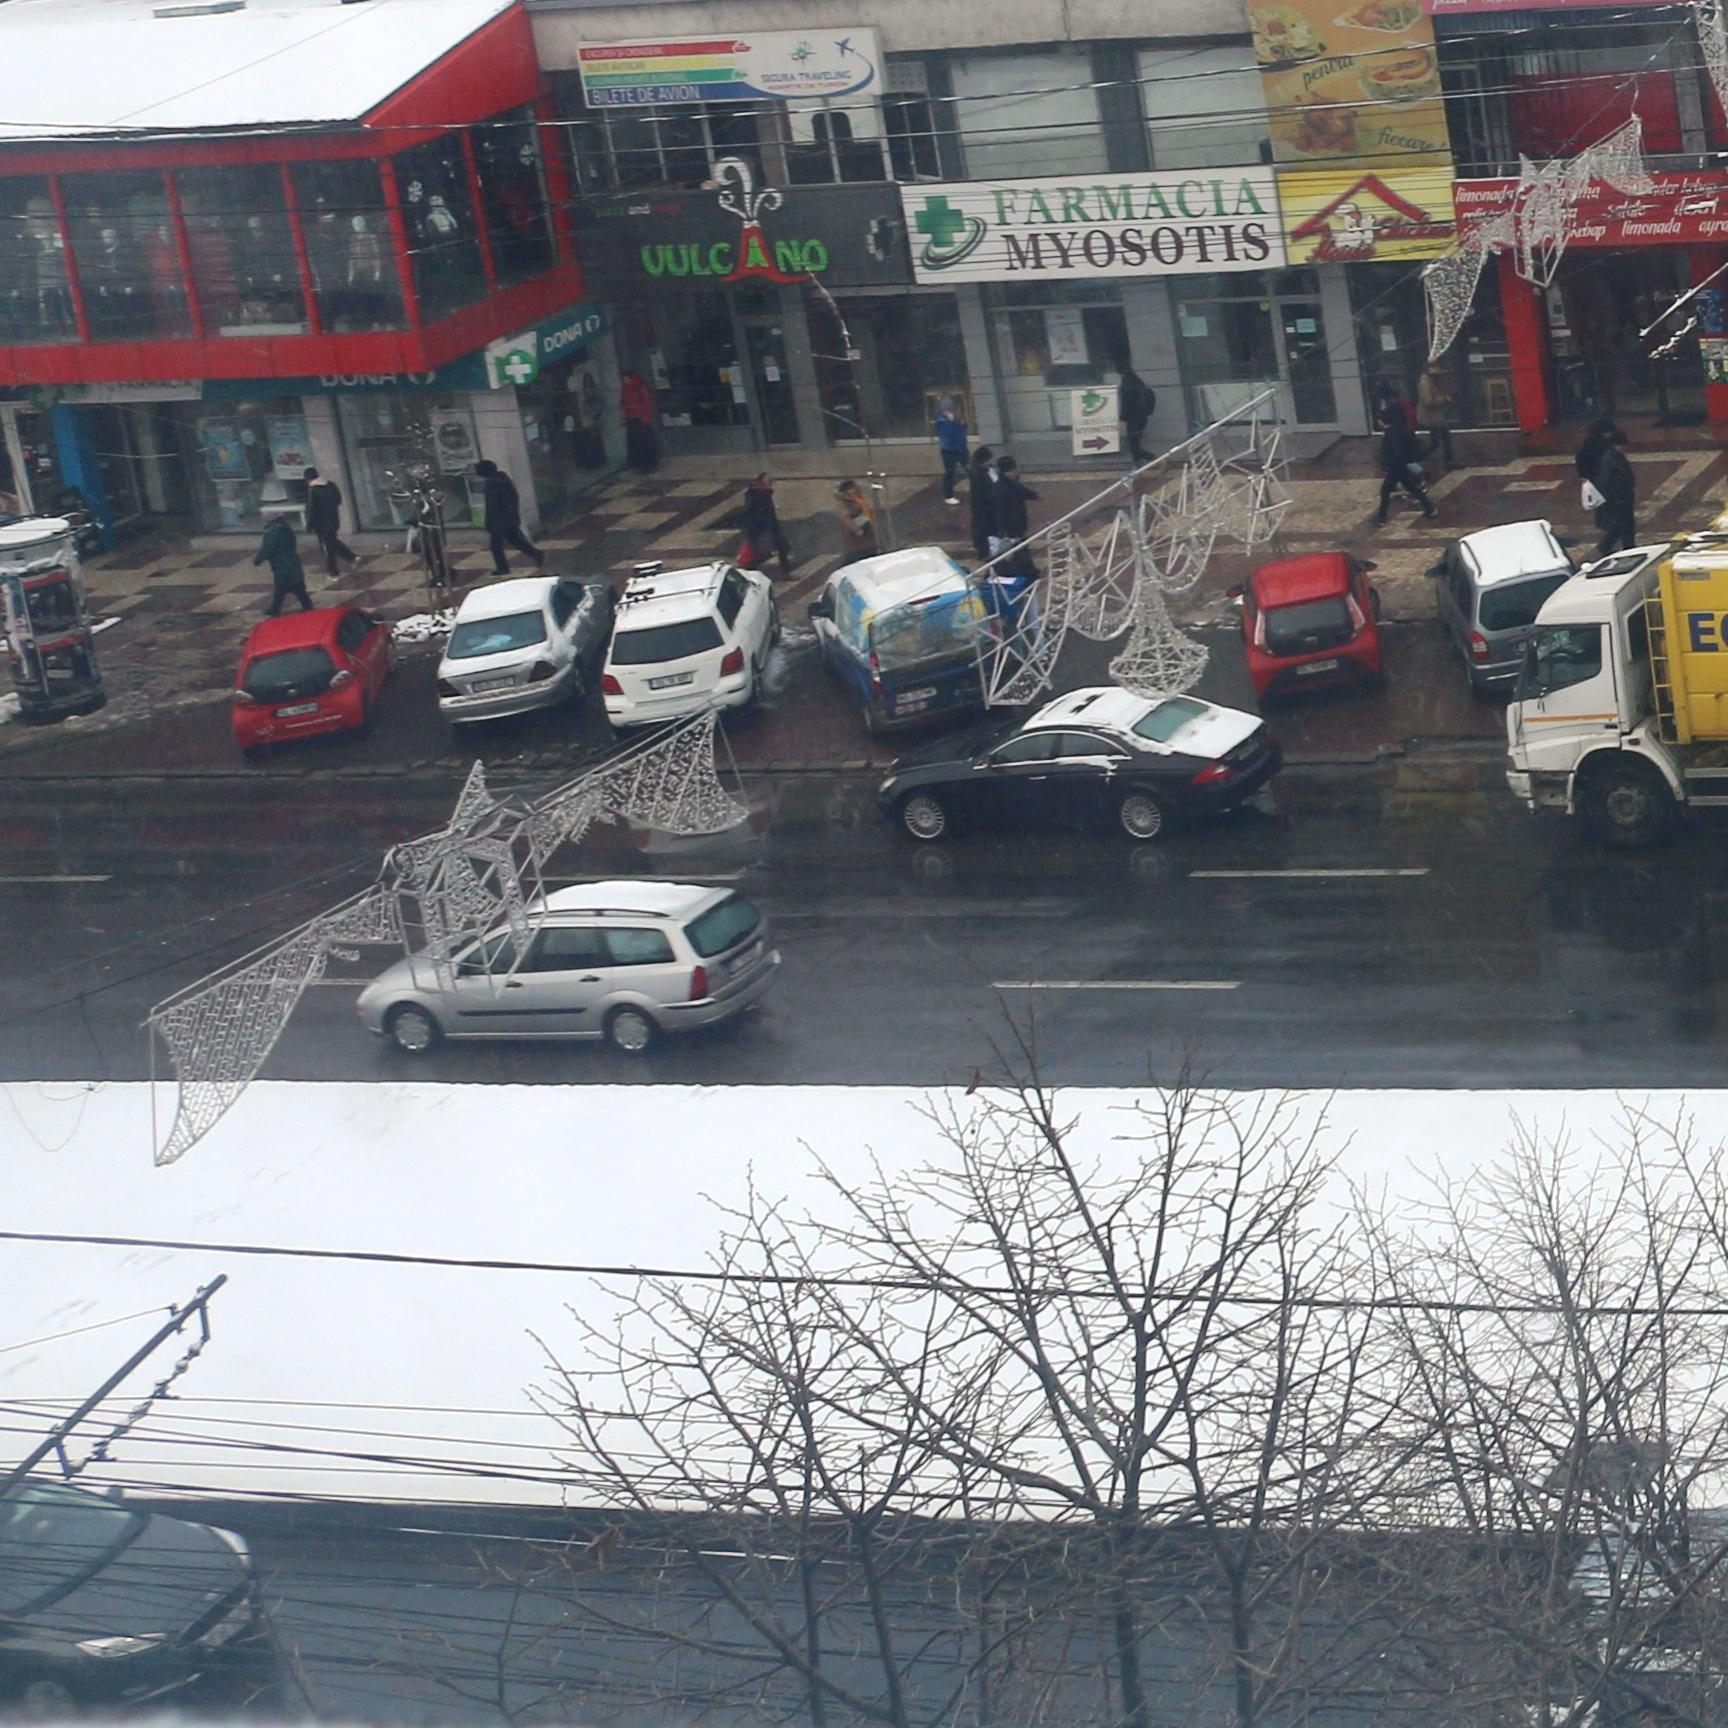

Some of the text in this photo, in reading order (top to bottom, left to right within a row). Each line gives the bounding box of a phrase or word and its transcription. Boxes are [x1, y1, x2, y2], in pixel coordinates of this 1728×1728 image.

[592, 85, 700, 104] BILETE DE AVION
[990, 178, 1267, 226] FARMACIA
[1002, 222, 1270, 271] MYOSOTIS
[1621, 218, 1682, 237] limonada
[640, 227, 830, 282] VULCANO
[542, 322, 586, 354] DONA
